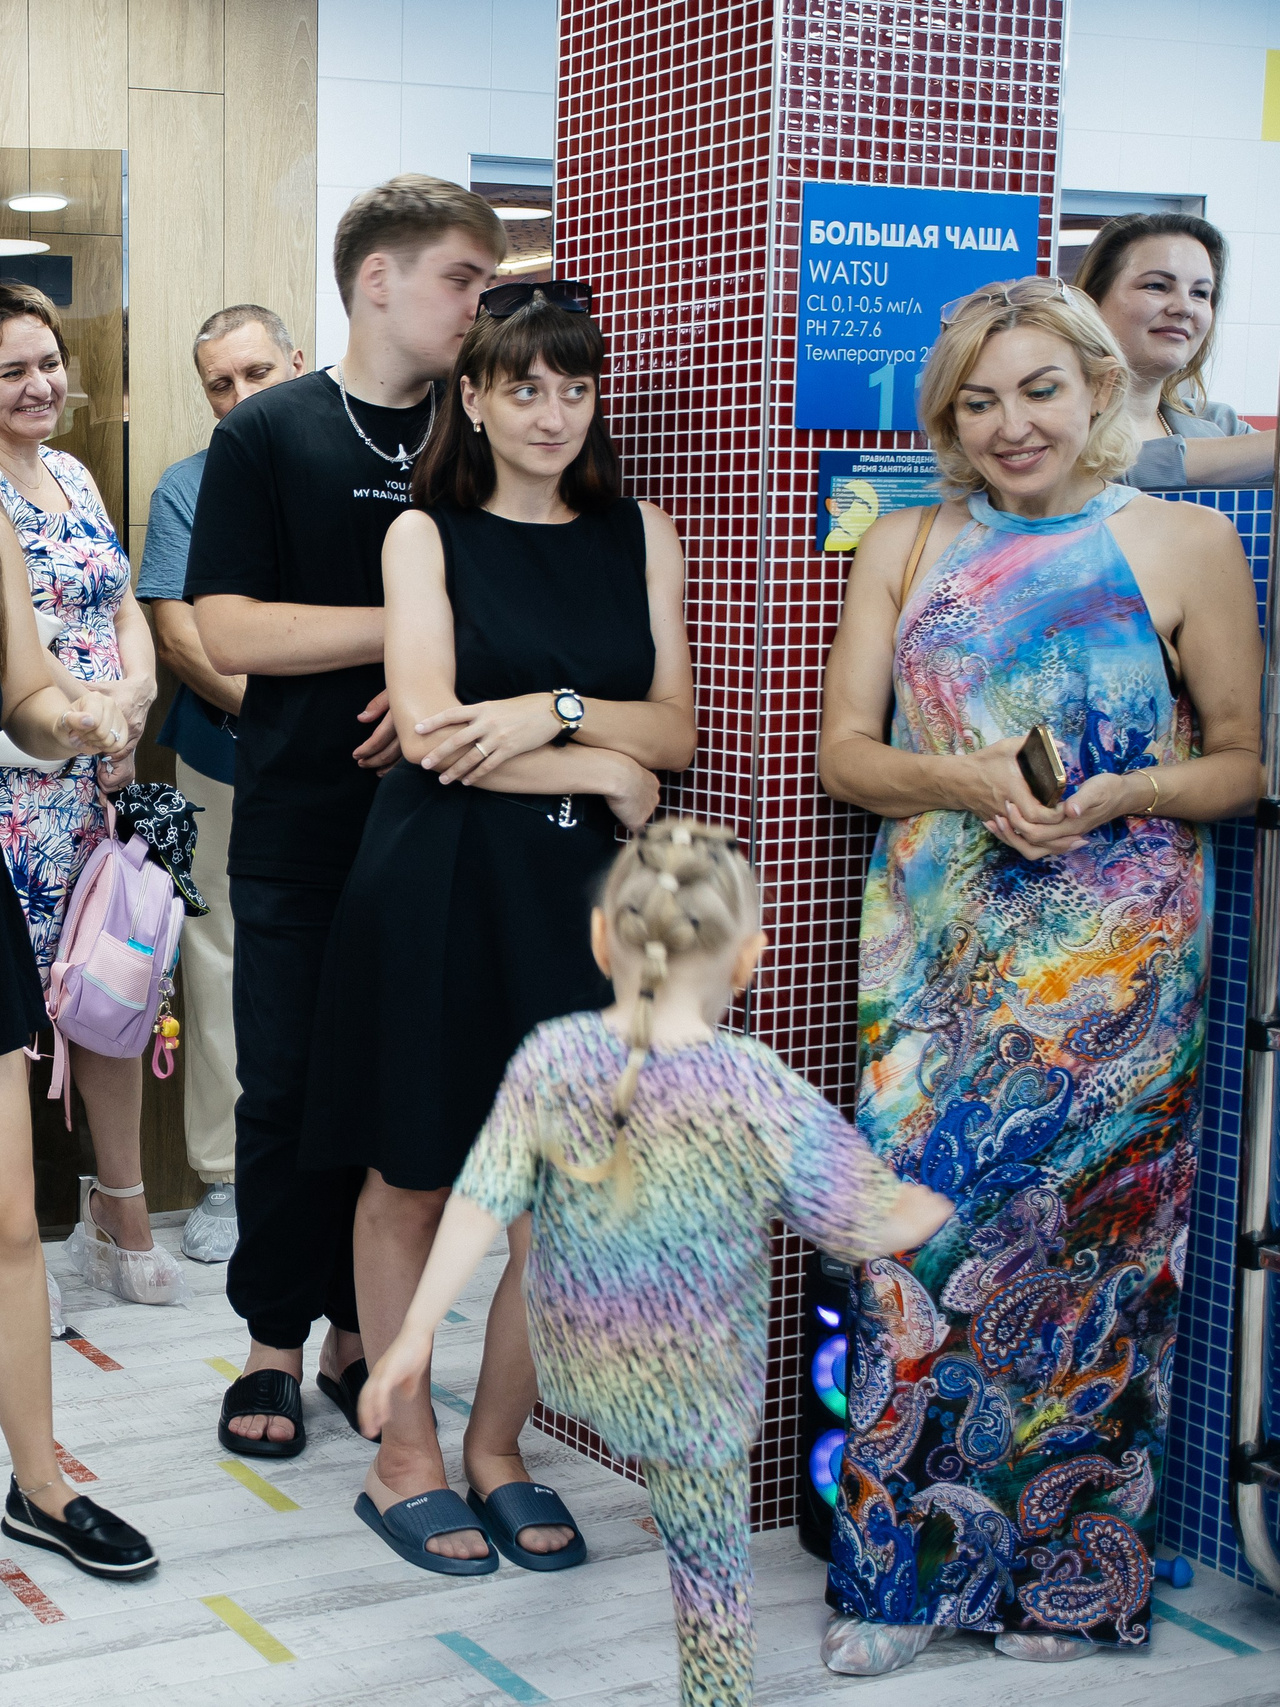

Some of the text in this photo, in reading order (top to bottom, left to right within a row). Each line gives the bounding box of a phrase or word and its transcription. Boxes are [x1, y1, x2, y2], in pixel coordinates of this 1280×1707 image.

[809, 219, 1020, 252] БОЛЬШАЯ ЧАША
[808, 259, 889, 287] WATSU
[806, 294, 923, 316] CL 0,1-0,5 мг/л
[805, 319, 882, 338] PH 7.2-7.6
[805, 344, 916, 366] Температура
[852, 464, 878, 473] ВРЕМЯ
[878, 463, 912, 474] ЗАНЯТИЙ
[859, 454, 938, 465] ПРАВИЛА ПОВЕДЕНИ
[384, 479, 406, 491] YOU
[352, 488, 371, 498] MY
[372, 489, 407, 503] RADAR
